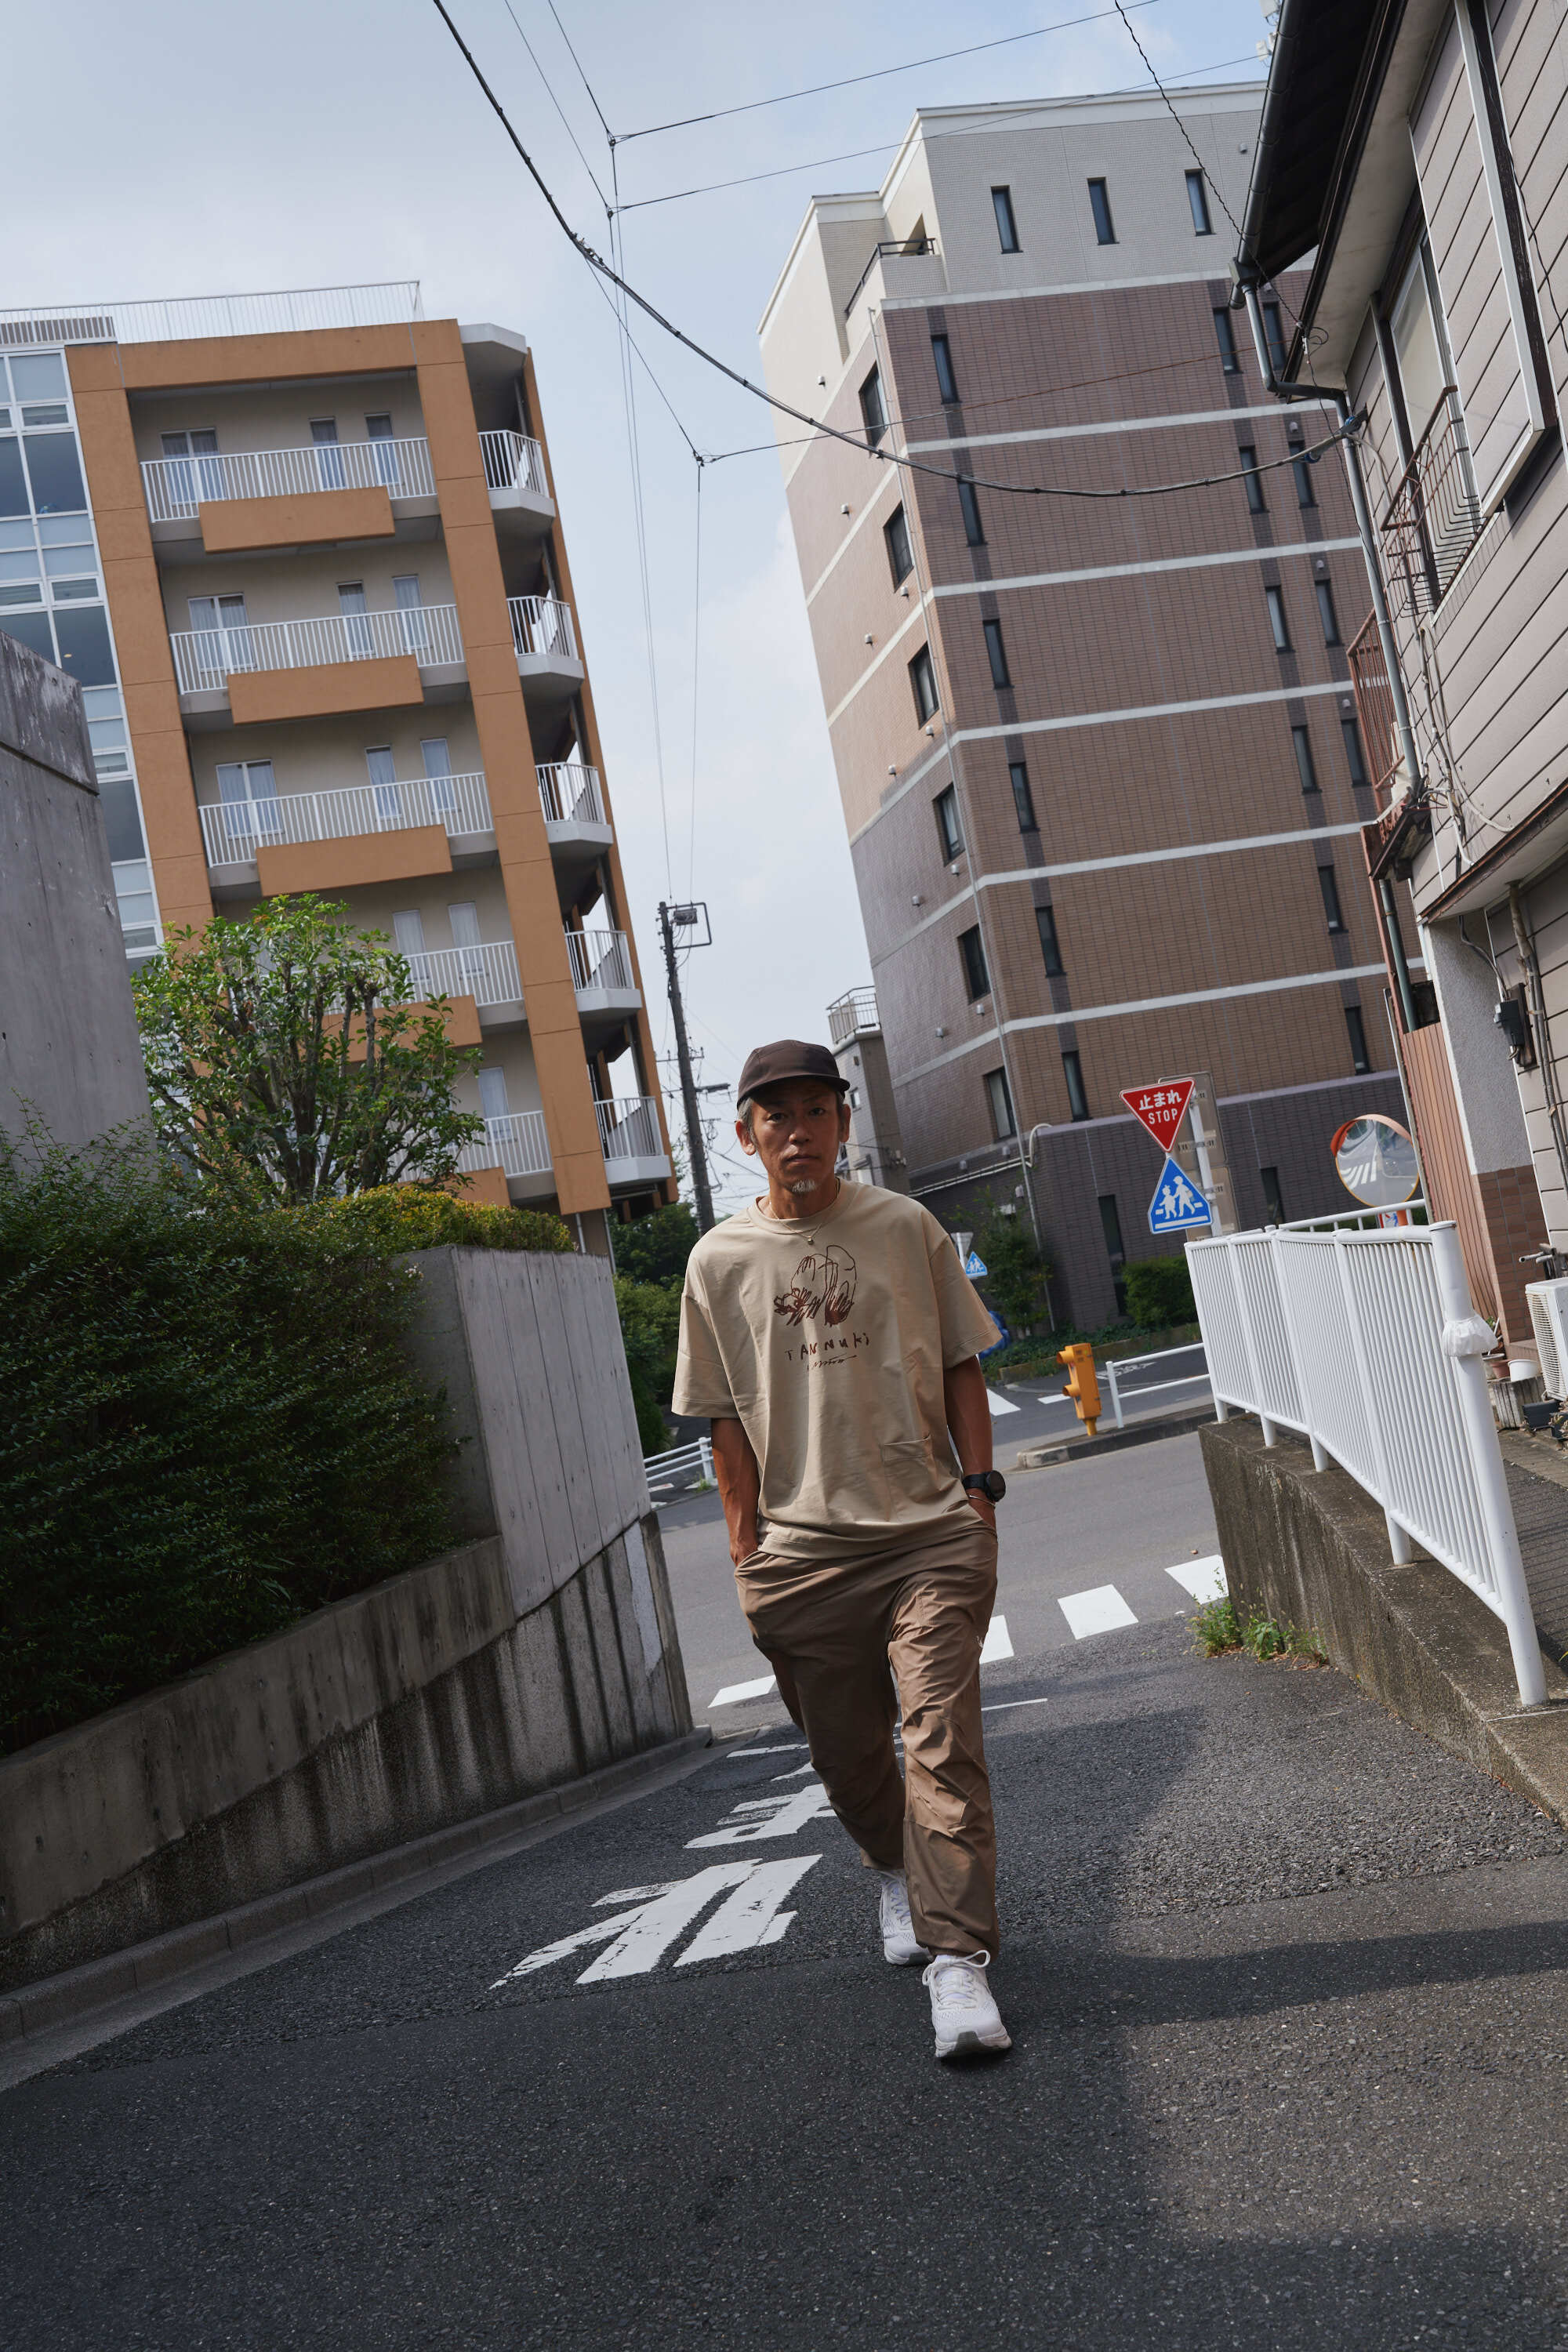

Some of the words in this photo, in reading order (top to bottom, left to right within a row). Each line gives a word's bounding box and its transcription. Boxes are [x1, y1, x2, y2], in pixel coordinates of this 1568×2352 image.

[1139, 1089, 1181, 1110] 止まれ
[1149, 1109, 1178, 1124] STOP
